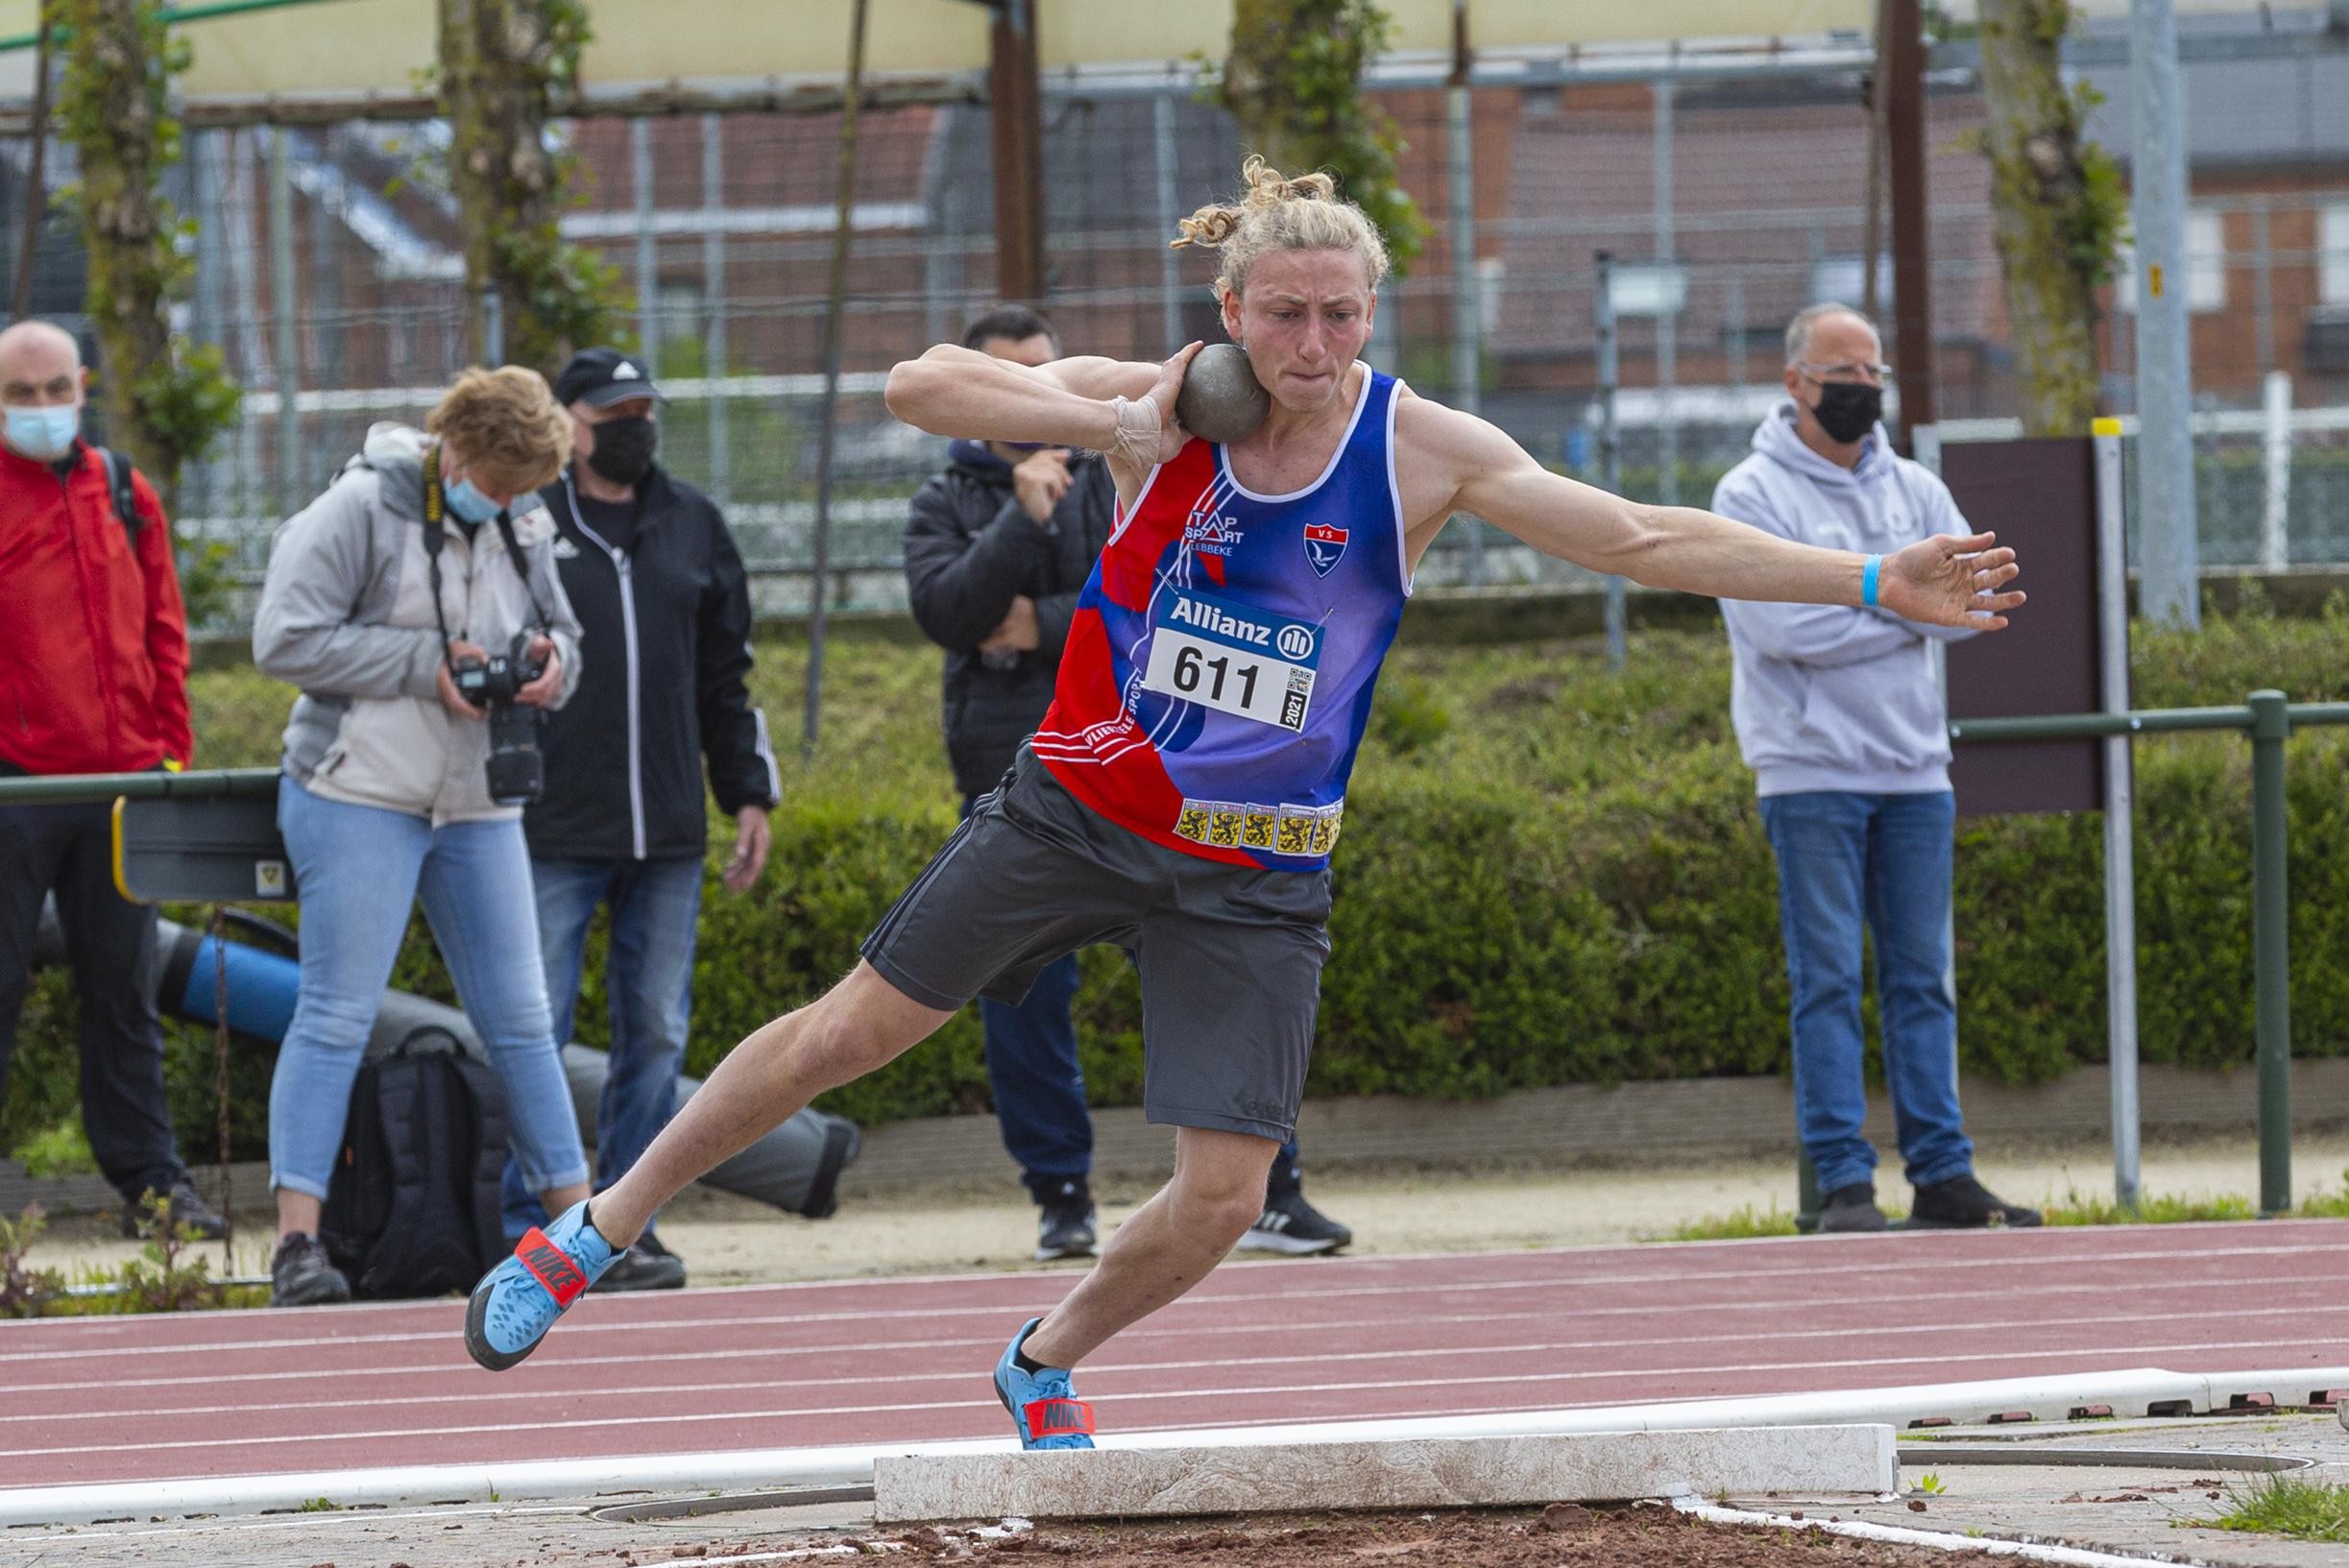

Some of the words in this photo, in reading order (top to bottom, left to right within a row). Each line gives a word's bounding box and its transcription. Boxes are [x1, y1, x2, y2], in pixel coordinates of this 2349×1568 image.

[1190, 543, 1233, 557] LEBBEKE
[1170, 596, 1272, 646] Allianz
[1174, 645, 1260, 710] 611
[1285, 694, 1303, 730] 2021
[524, 1244, 582, 1291] NIKE
[1043, 1402, 1086, 1430] NIKE
